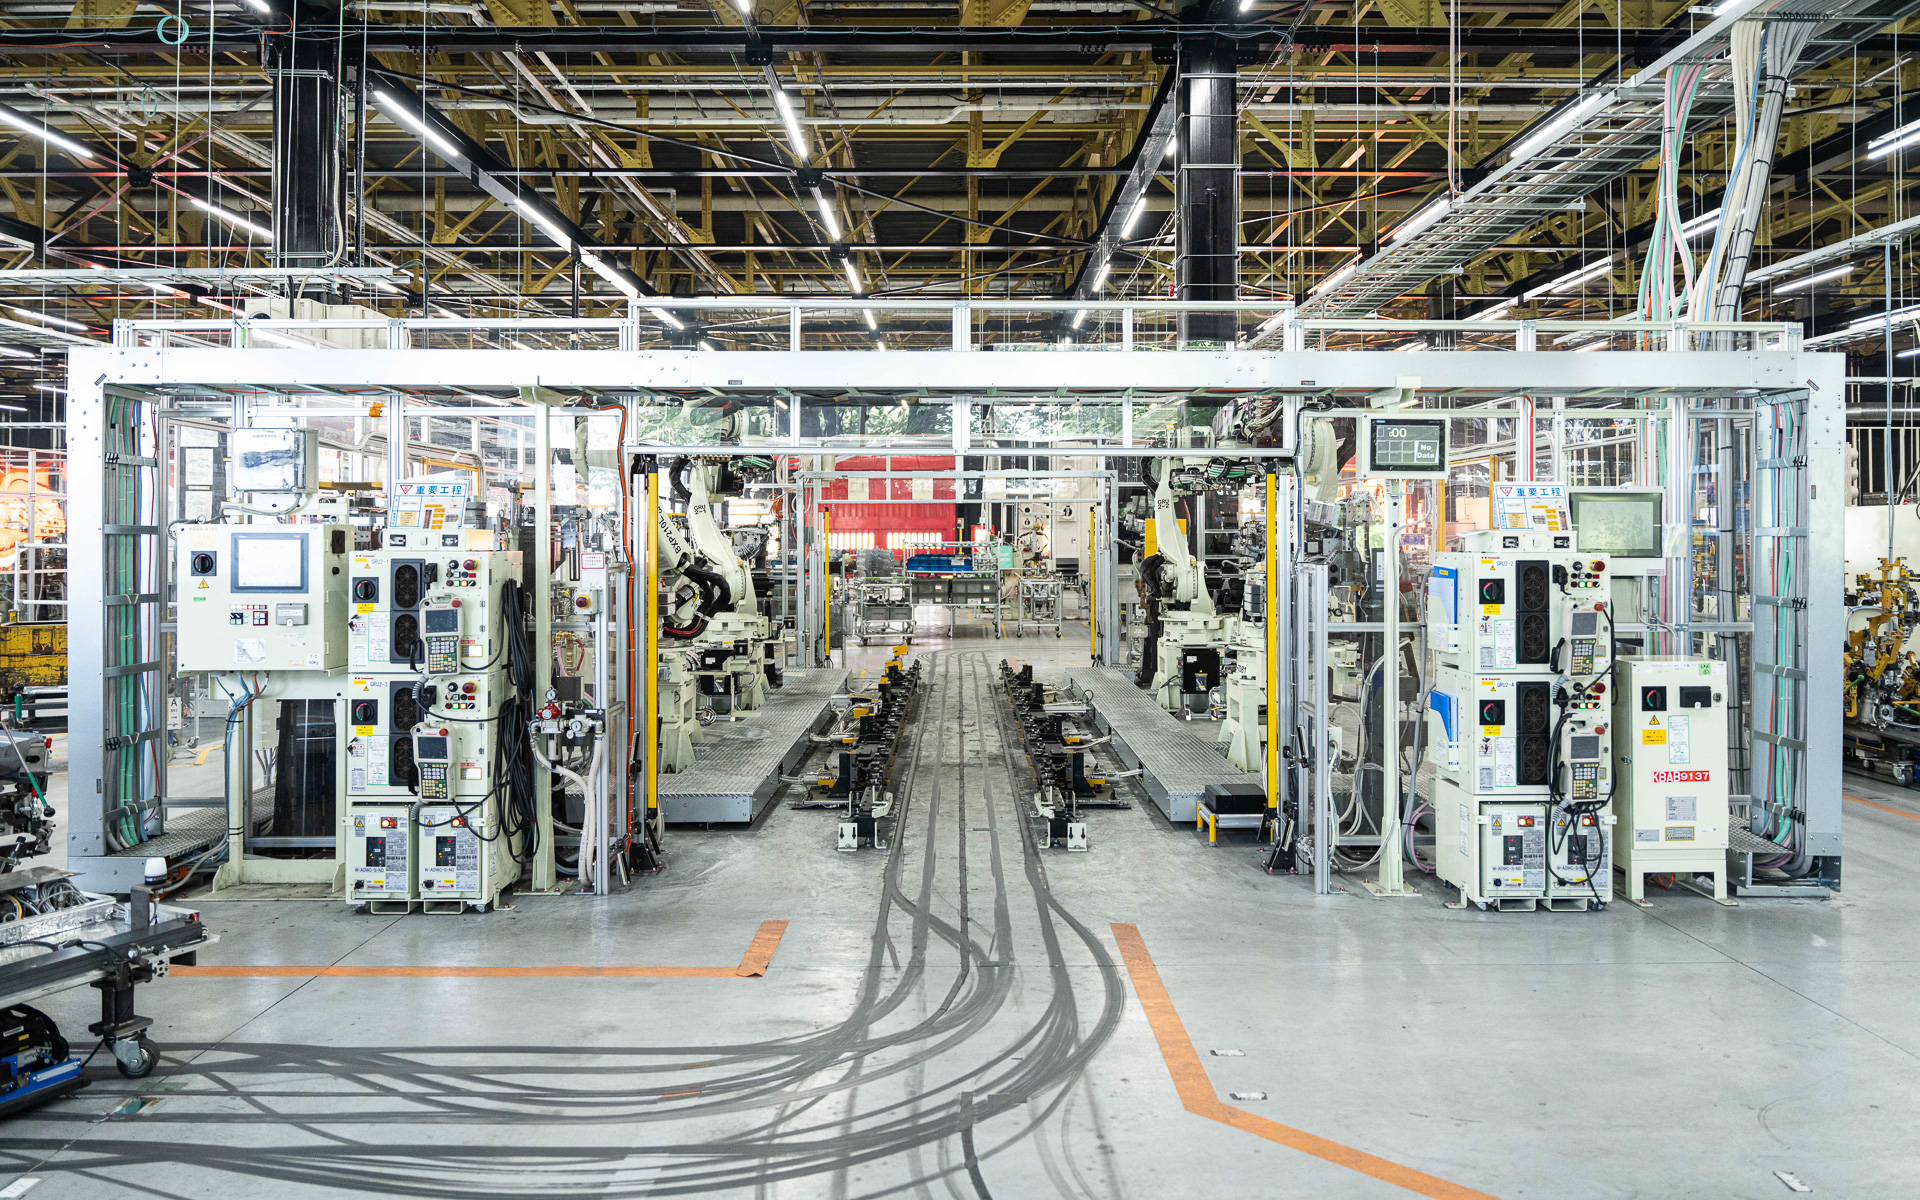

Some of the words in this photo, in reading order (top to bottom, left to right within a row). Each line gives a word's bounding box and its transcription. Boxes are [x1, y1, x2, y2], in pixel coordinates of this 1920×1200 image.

[415, 485, 462, 495] 重要工程
[1516, 487, 1562, 497] 重要工程
[1652, 771, 1709, 783] KBAB9137
